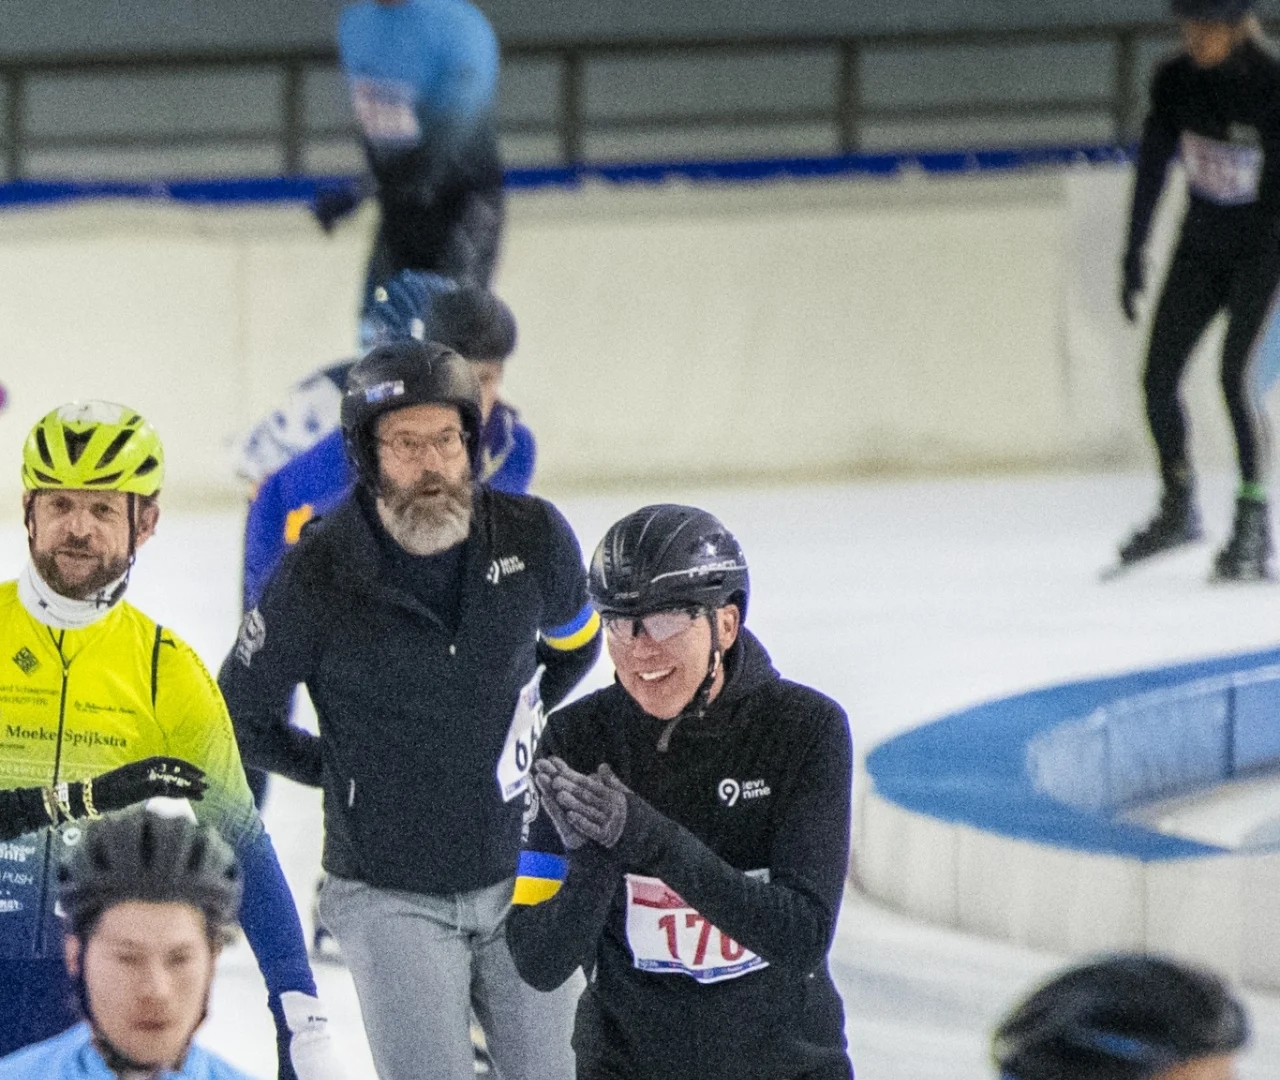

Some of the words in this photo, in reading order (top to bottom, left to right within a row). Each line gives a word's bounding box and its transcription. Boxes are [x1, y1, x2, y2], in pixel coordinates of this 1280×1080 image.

[6, 724, 57, 742] Moeke
[64, 729, 128, 749] Spijkstra
[742, 779, 765, 791] levi
[742, 785, 771, 799] nine
[3, 871, 34, 885] PUSH
